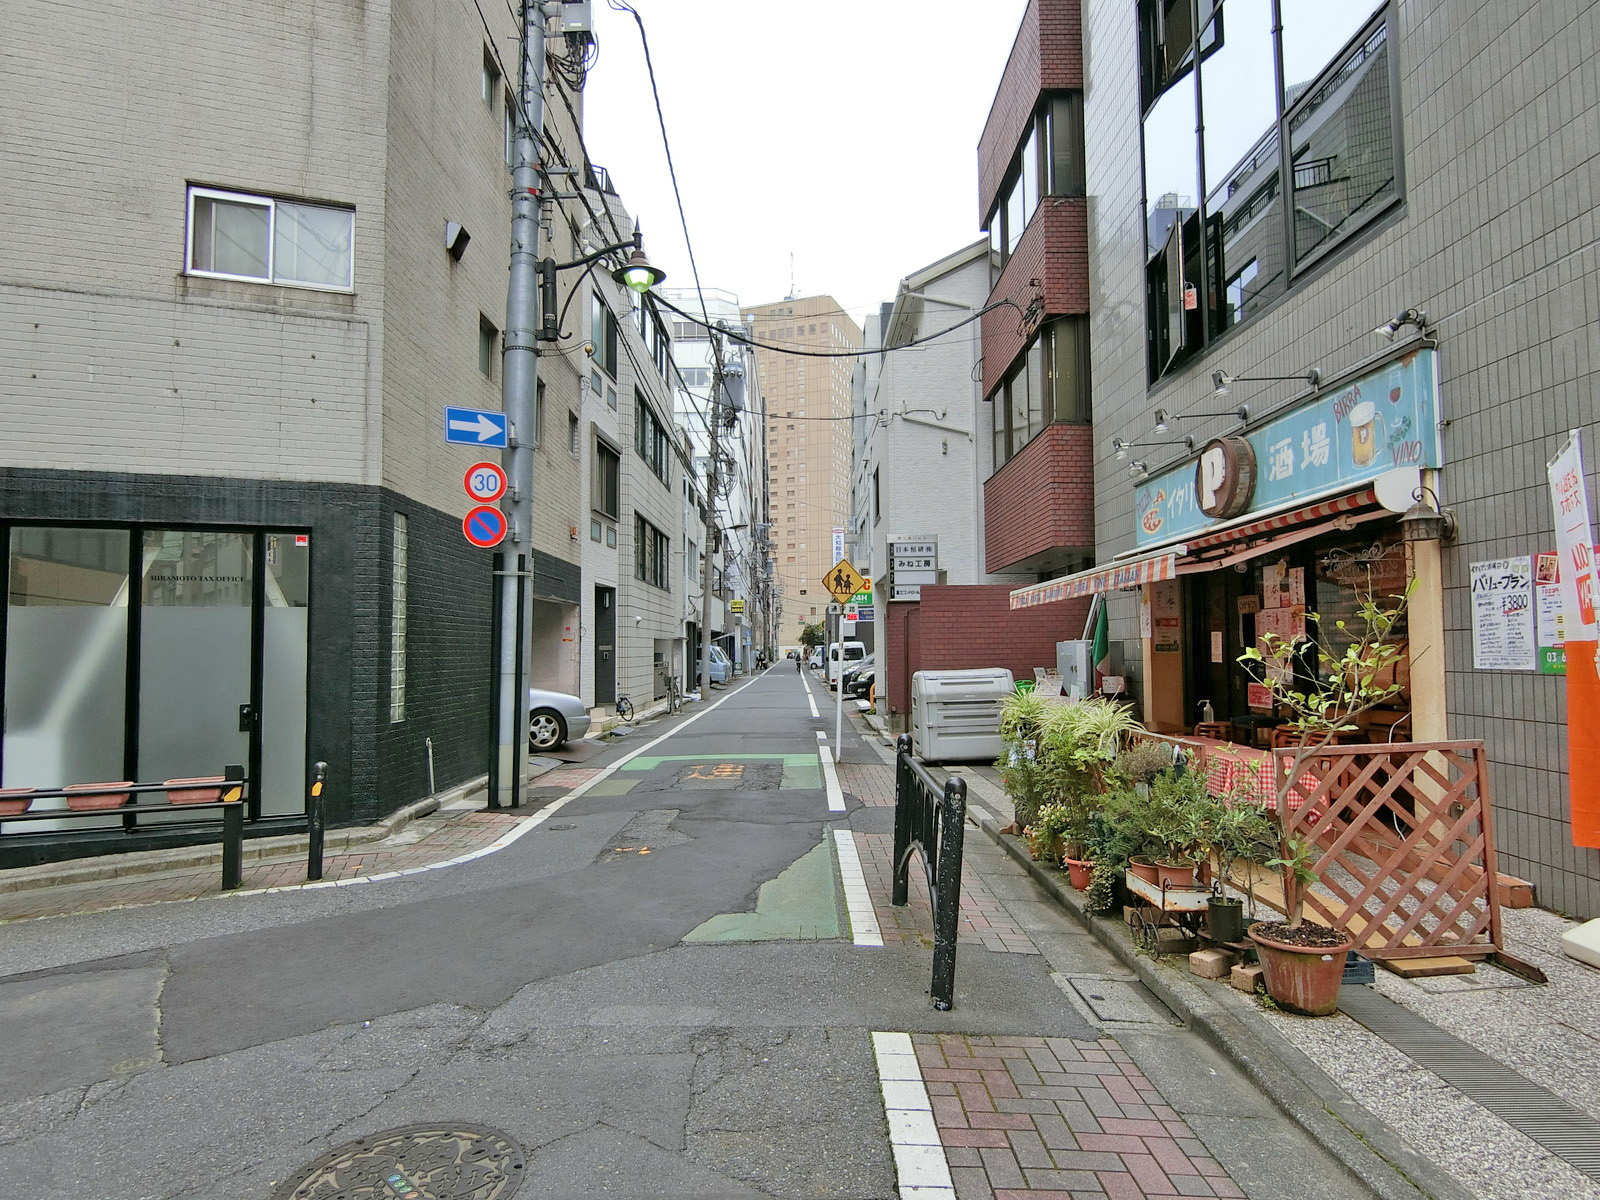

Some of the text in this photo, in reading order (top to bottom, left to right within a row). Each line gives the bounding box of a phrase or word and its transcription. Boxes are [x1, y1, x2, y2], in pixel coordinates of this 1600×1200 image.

[1333, 384, 1361, 424] BIRRA
[1392, 440, 1422, 466] VINO
[474, 474, 498, 492] 30
[1167, 480, 1199, 519] イタリ
[1268, 423, 1330, 481] 酒場
